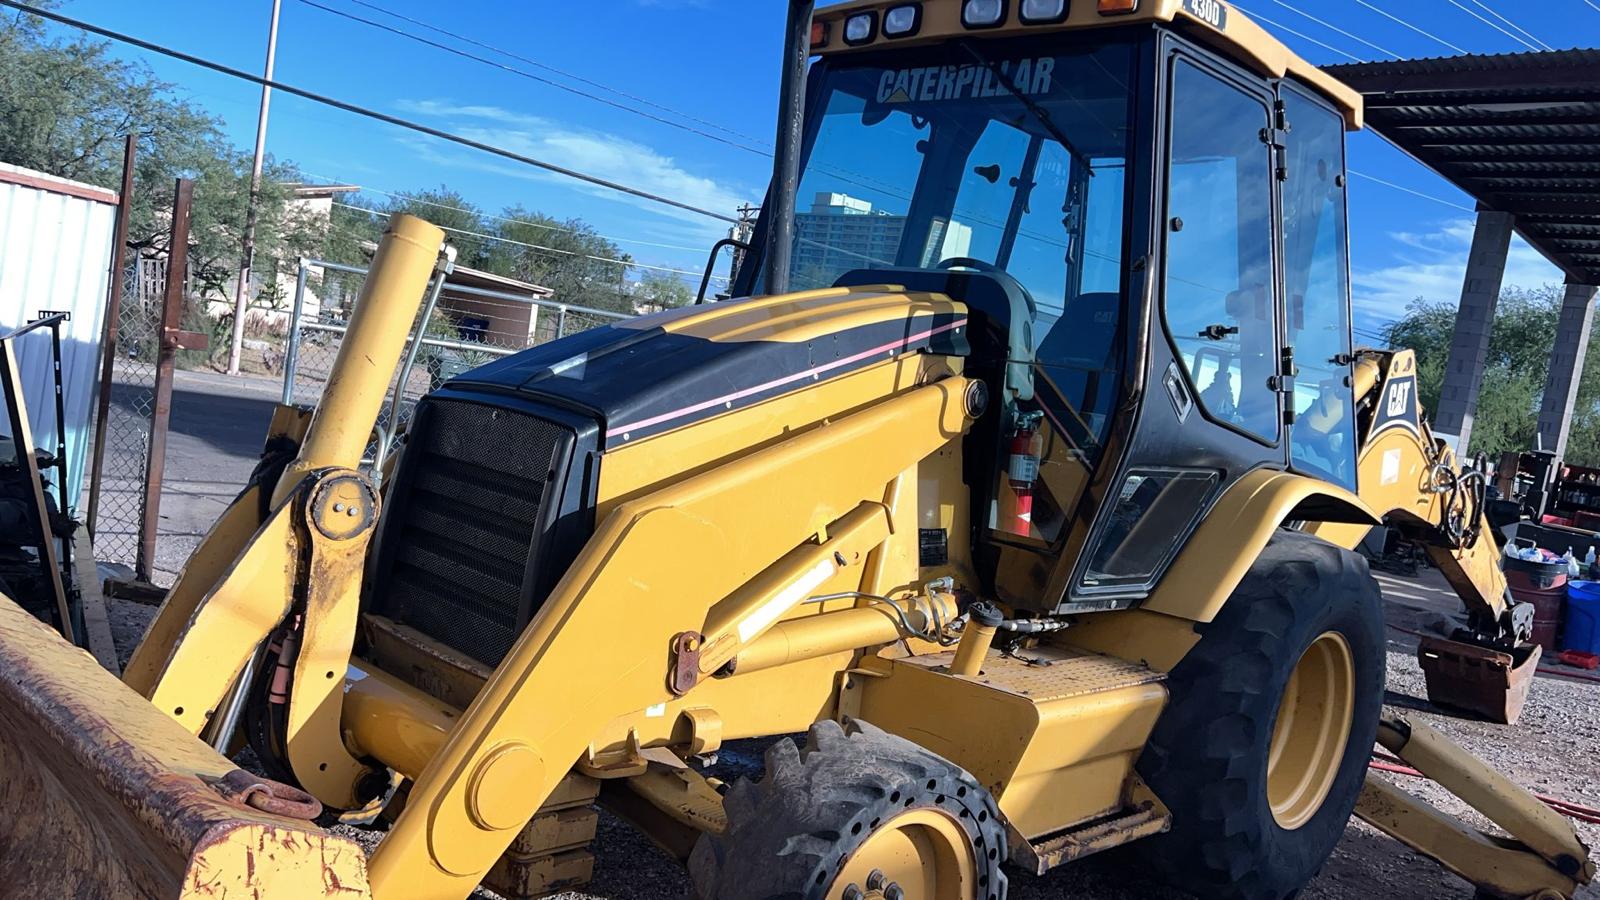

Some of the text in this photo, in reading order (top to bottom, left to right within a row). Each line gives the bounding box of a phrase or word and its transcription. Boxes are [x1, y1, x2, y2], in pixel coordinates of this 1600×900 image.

[1191, 0, 1220, 26] 430D
[876, 57, 1055, 103] CATERPILLAR
[1387, 381, 1411, 417] CAT
